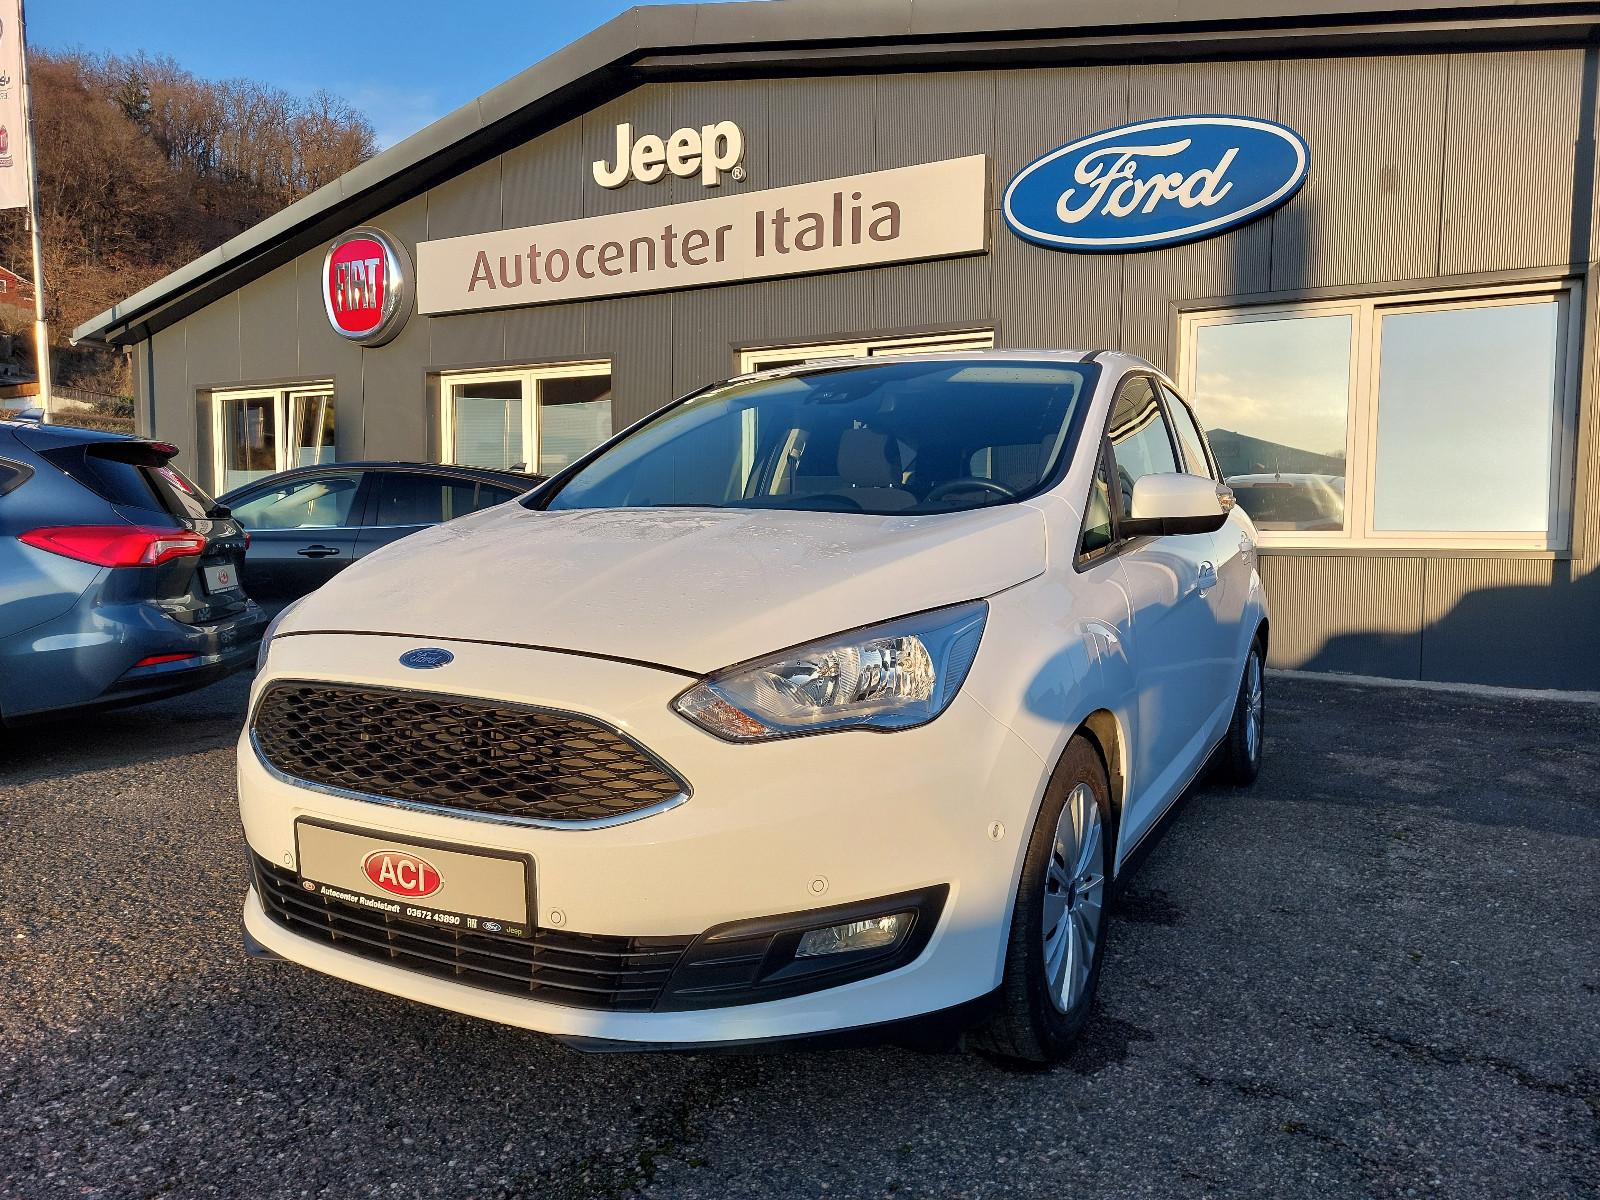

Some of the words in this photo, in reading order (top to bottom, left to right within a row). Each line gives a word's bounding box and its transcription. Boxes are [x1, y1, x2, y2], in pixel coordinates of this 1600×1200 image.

[592, 120, 744, 188] Jeep
[1056, 138, 1239, 224] Ford
[468, 223, 733, 293] Autocenter
[754, 191, 901, 258] Italia
[334, 258, 380, 313] FIAT
[379, 856, 425, 892] ACI
[320, 886, 358, 903] Autocenter
[359, 896, 400, 913] Rudolstadt
[406, 907, 432, 920] 03672
[433, 913, 460, 925] 43890
[506, 926, 522, 936] Jeep
